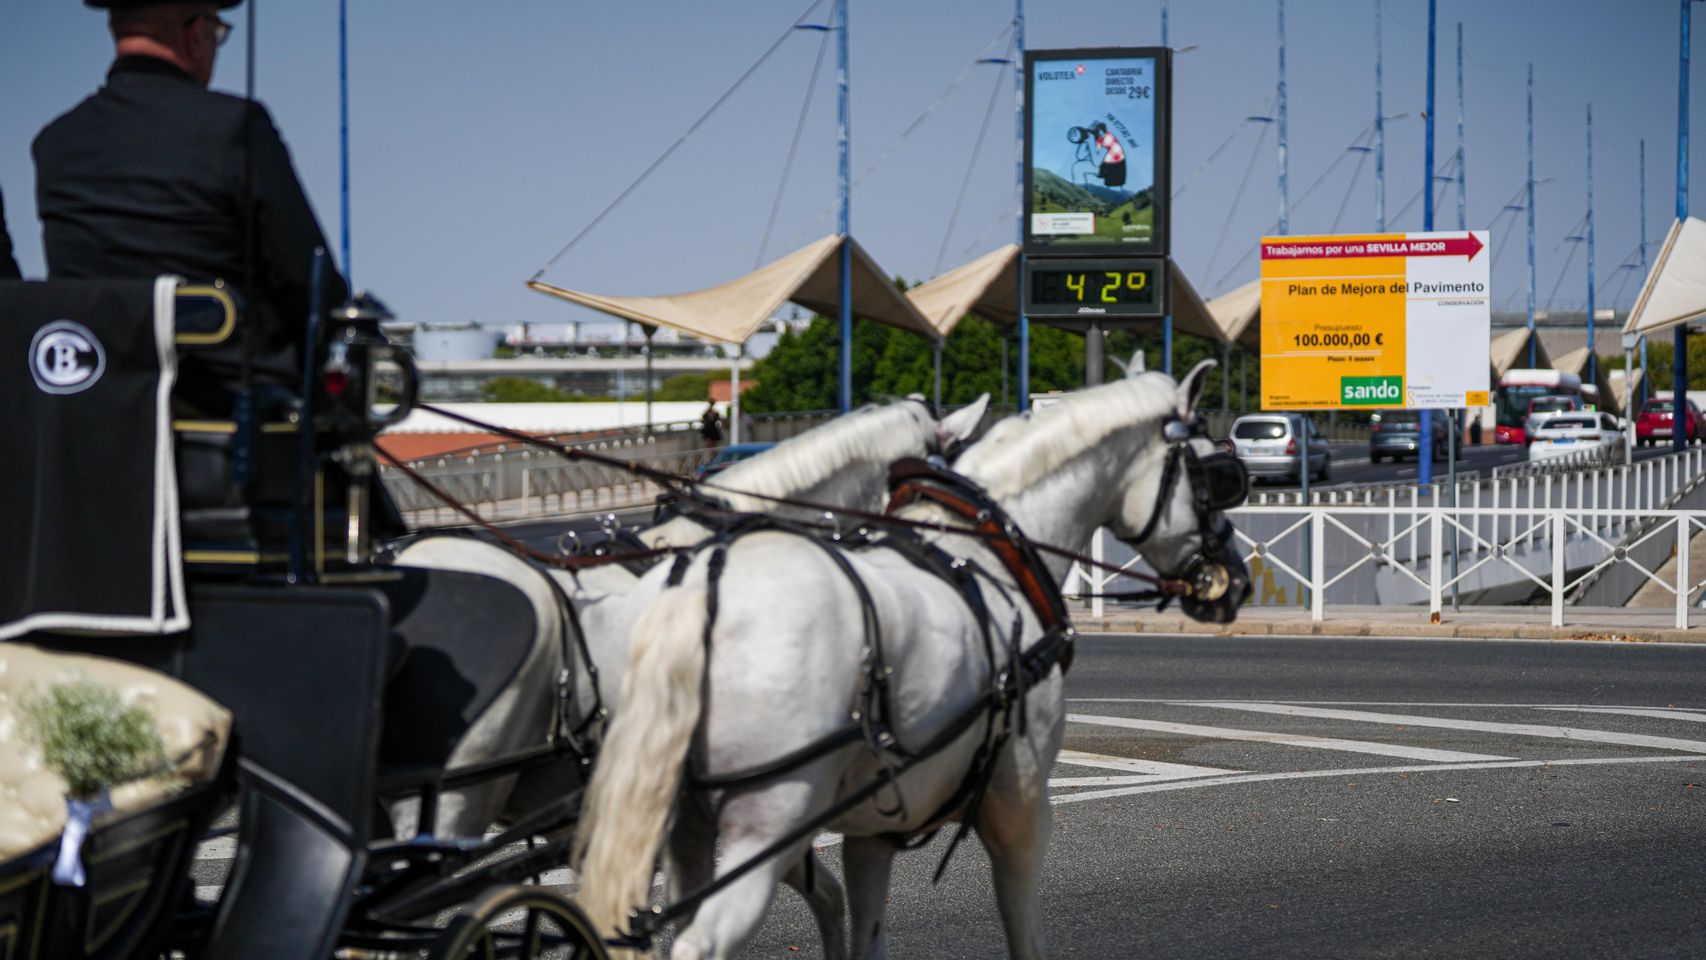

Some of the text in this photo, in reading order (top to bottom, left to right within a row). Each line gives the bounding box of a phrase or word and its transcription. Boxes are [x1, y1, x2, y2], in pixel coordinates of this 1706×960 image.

[1039, 71, 1075, 80] VOLOTEA
[1105, 68, 1143, 76] CANTABRIA
[1105, 77, 1134, 85] DIRECTO
[1105, 86, 1150, 99] DESDE 29€
[1266, 245, 1324, 257] Trabajamos
[1326, 246, 1342, 256] por
[1366, 243, 1407, 253] SEVILLA
[1410, 242, 1446, 252] MEJOR
[1288, 281, 1484, 298] Plan de Mejora del Pavimento
[1314, 324, 1363, 333] Presupuesto
[1294, 333, 1384, 348] 100.000,00 €
[1344, 380, 1400, 399] sando
